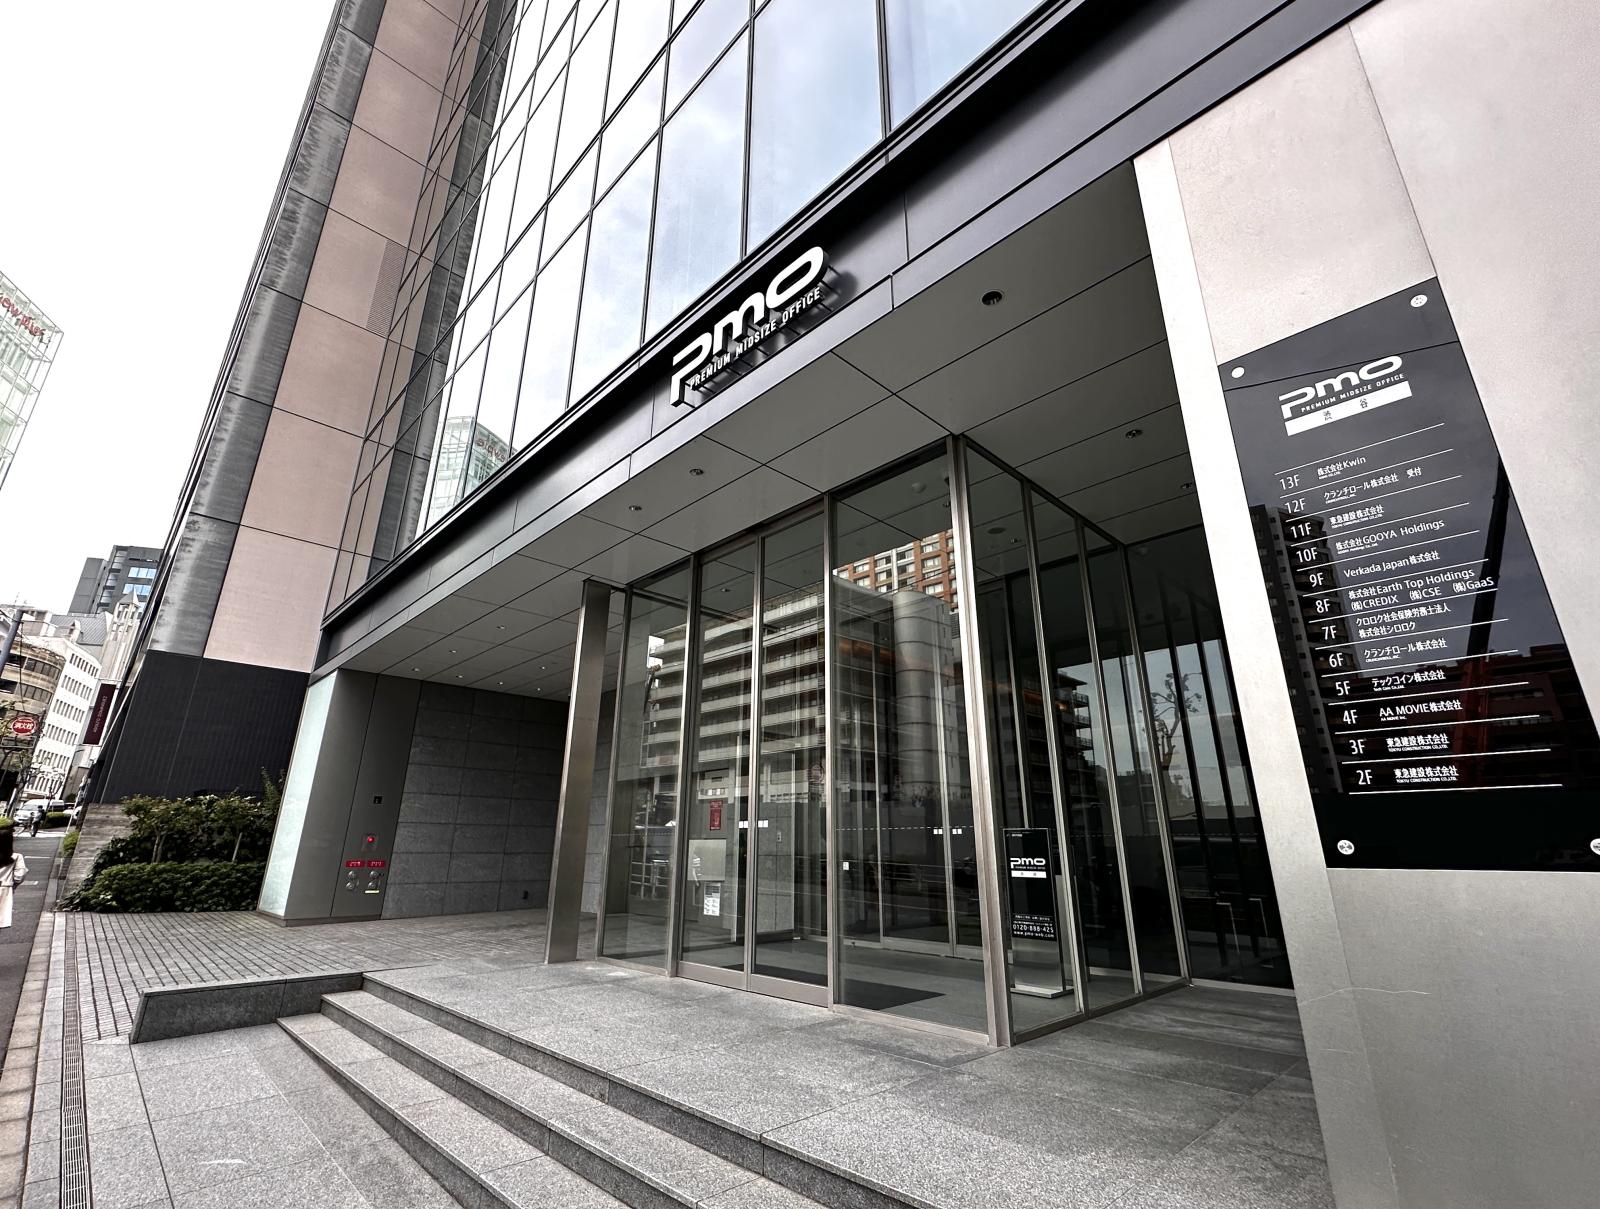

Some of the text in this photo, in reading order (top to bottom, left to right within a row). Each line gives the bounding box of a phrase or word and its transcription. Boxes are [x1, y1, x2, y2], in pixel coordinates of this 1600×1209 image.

[689, 286, 821, 390] PREMIUM MIDSIZE OFFICE
[1301, 373, 1405, 413] PREMIUM MIDSIZE OFFICE
[1280, 474, 1300, 491] 13F
[1317, 456, 1366, 476] 株式会社Kwin
[1284, 498, 1306, 514] 12F
[1323, 473, 1399, 500] クランチロール株式会社
[1406, 466, 1422, 478] 受付
[1290, 504, 1384, 538] 11F 東急建設株式会社
[1296, 519, 1445, 563] 10F 株式会社GOOYA Holdings
[1309, 550, 1440, 588] 9F Verkada Japan株式会社
[1316, 568, 1475, 614] 8F 株式会社Earth Top Holdings
[1321, 625, 1338, 640] 7F
[1358, 621, 1416, 639] 株式会社シロロク
[1328, 637, 1448, 668] 6F クランチロール株式会社
[1335, 669, 1446, 696] 5F テックコイン株式会社
[1342, 699, 1463, 725] 4F AA MOVIE株式会社
[1349, 733, 1450, 755] 3F 東急建設株式会社
[1356, 765, 1459, 785] 2F 東急建設株式会社
